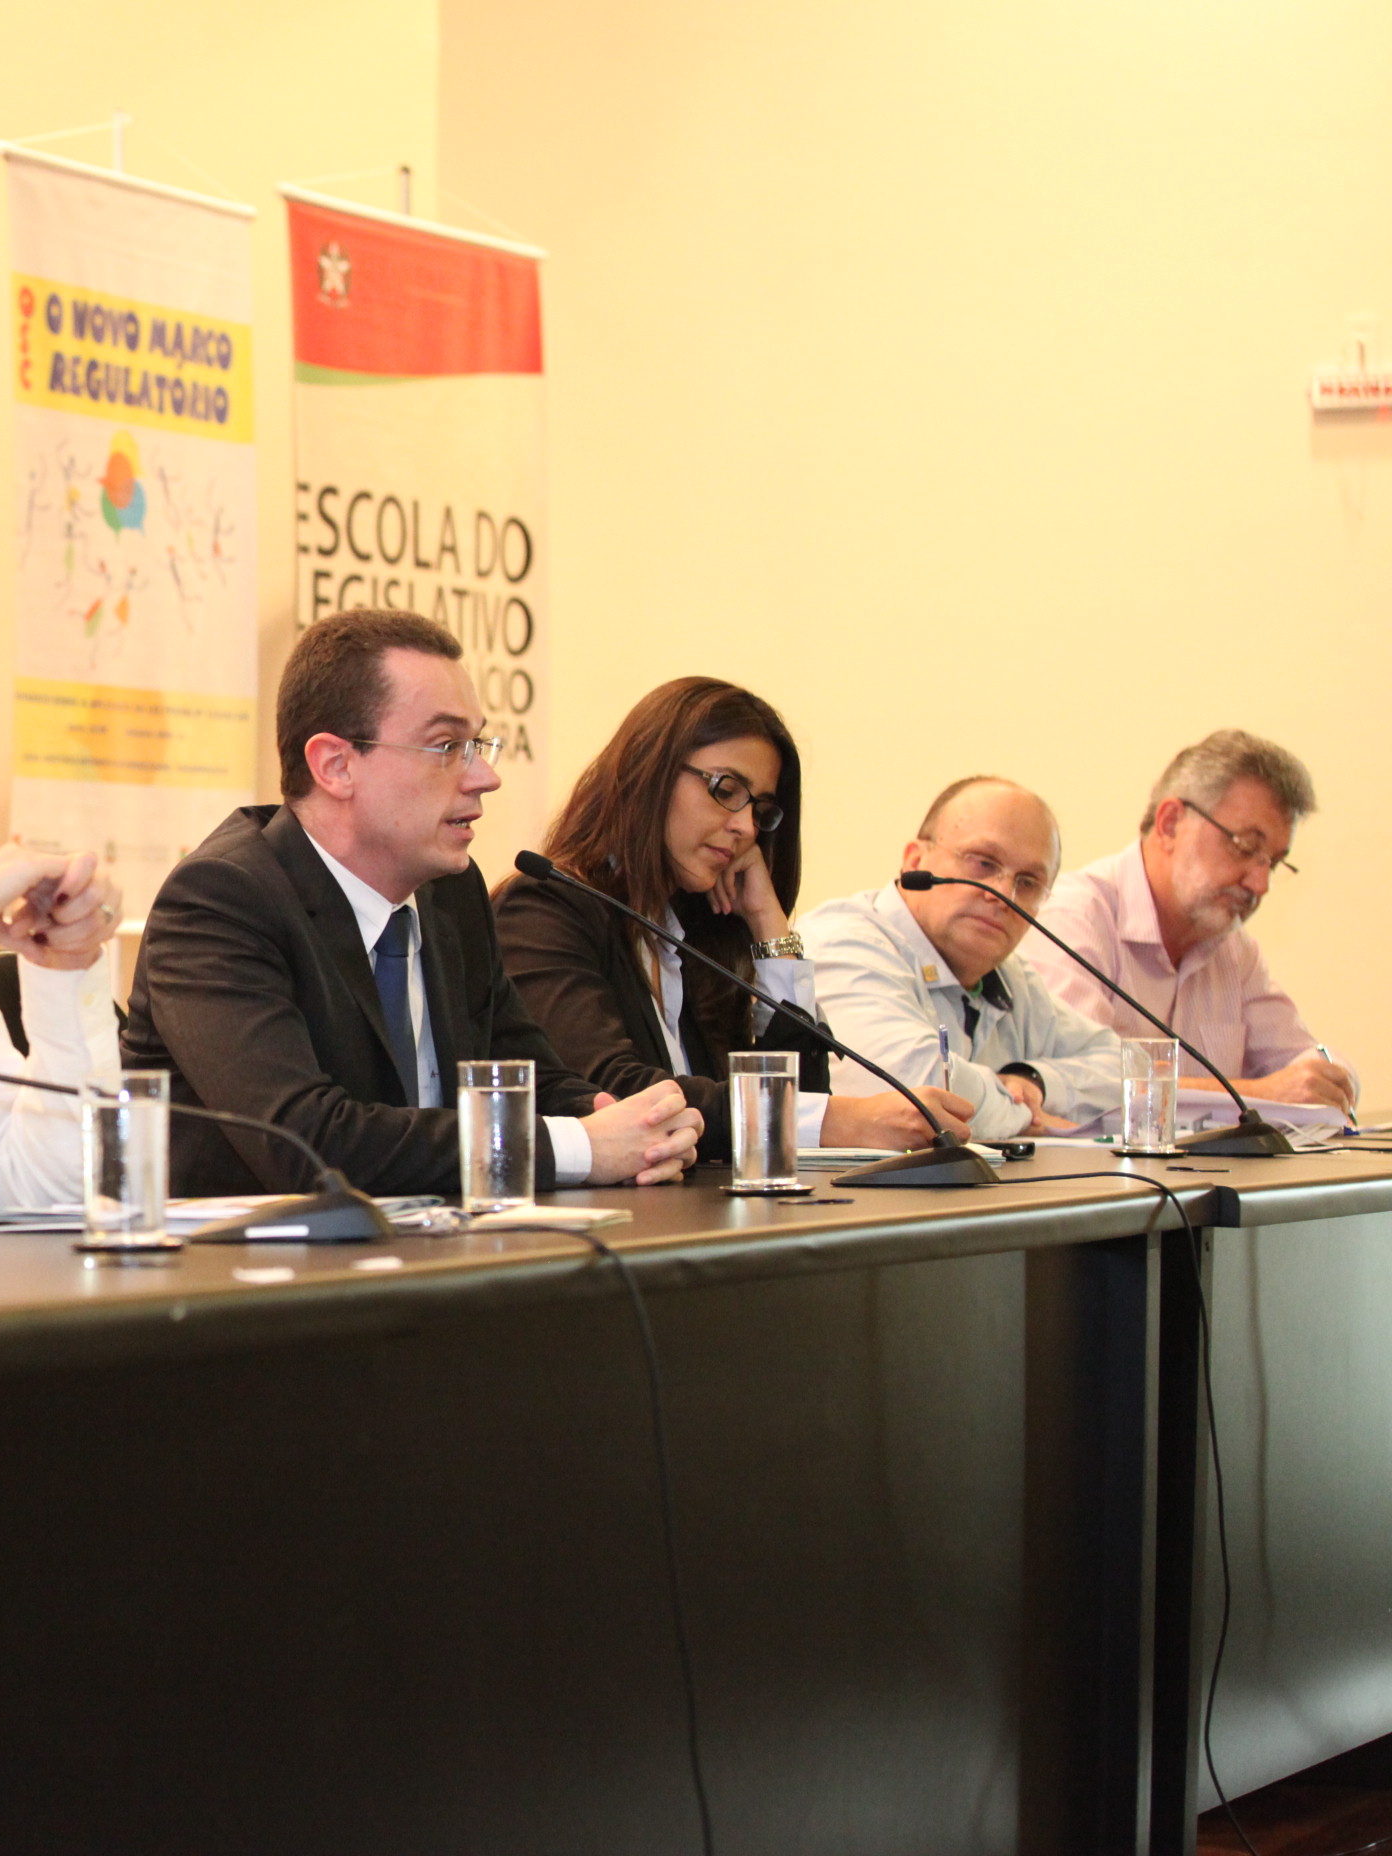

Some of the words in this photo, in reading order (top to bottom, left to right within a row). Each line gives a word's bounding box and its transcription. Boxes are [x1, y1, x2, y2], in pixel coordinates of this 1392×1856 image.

[45, 291, 62, 336] O
[72, 299, 140, 352] NOVO
[149, 316, 233, 370] MARCO
[475, 509, 533, 584] DO
